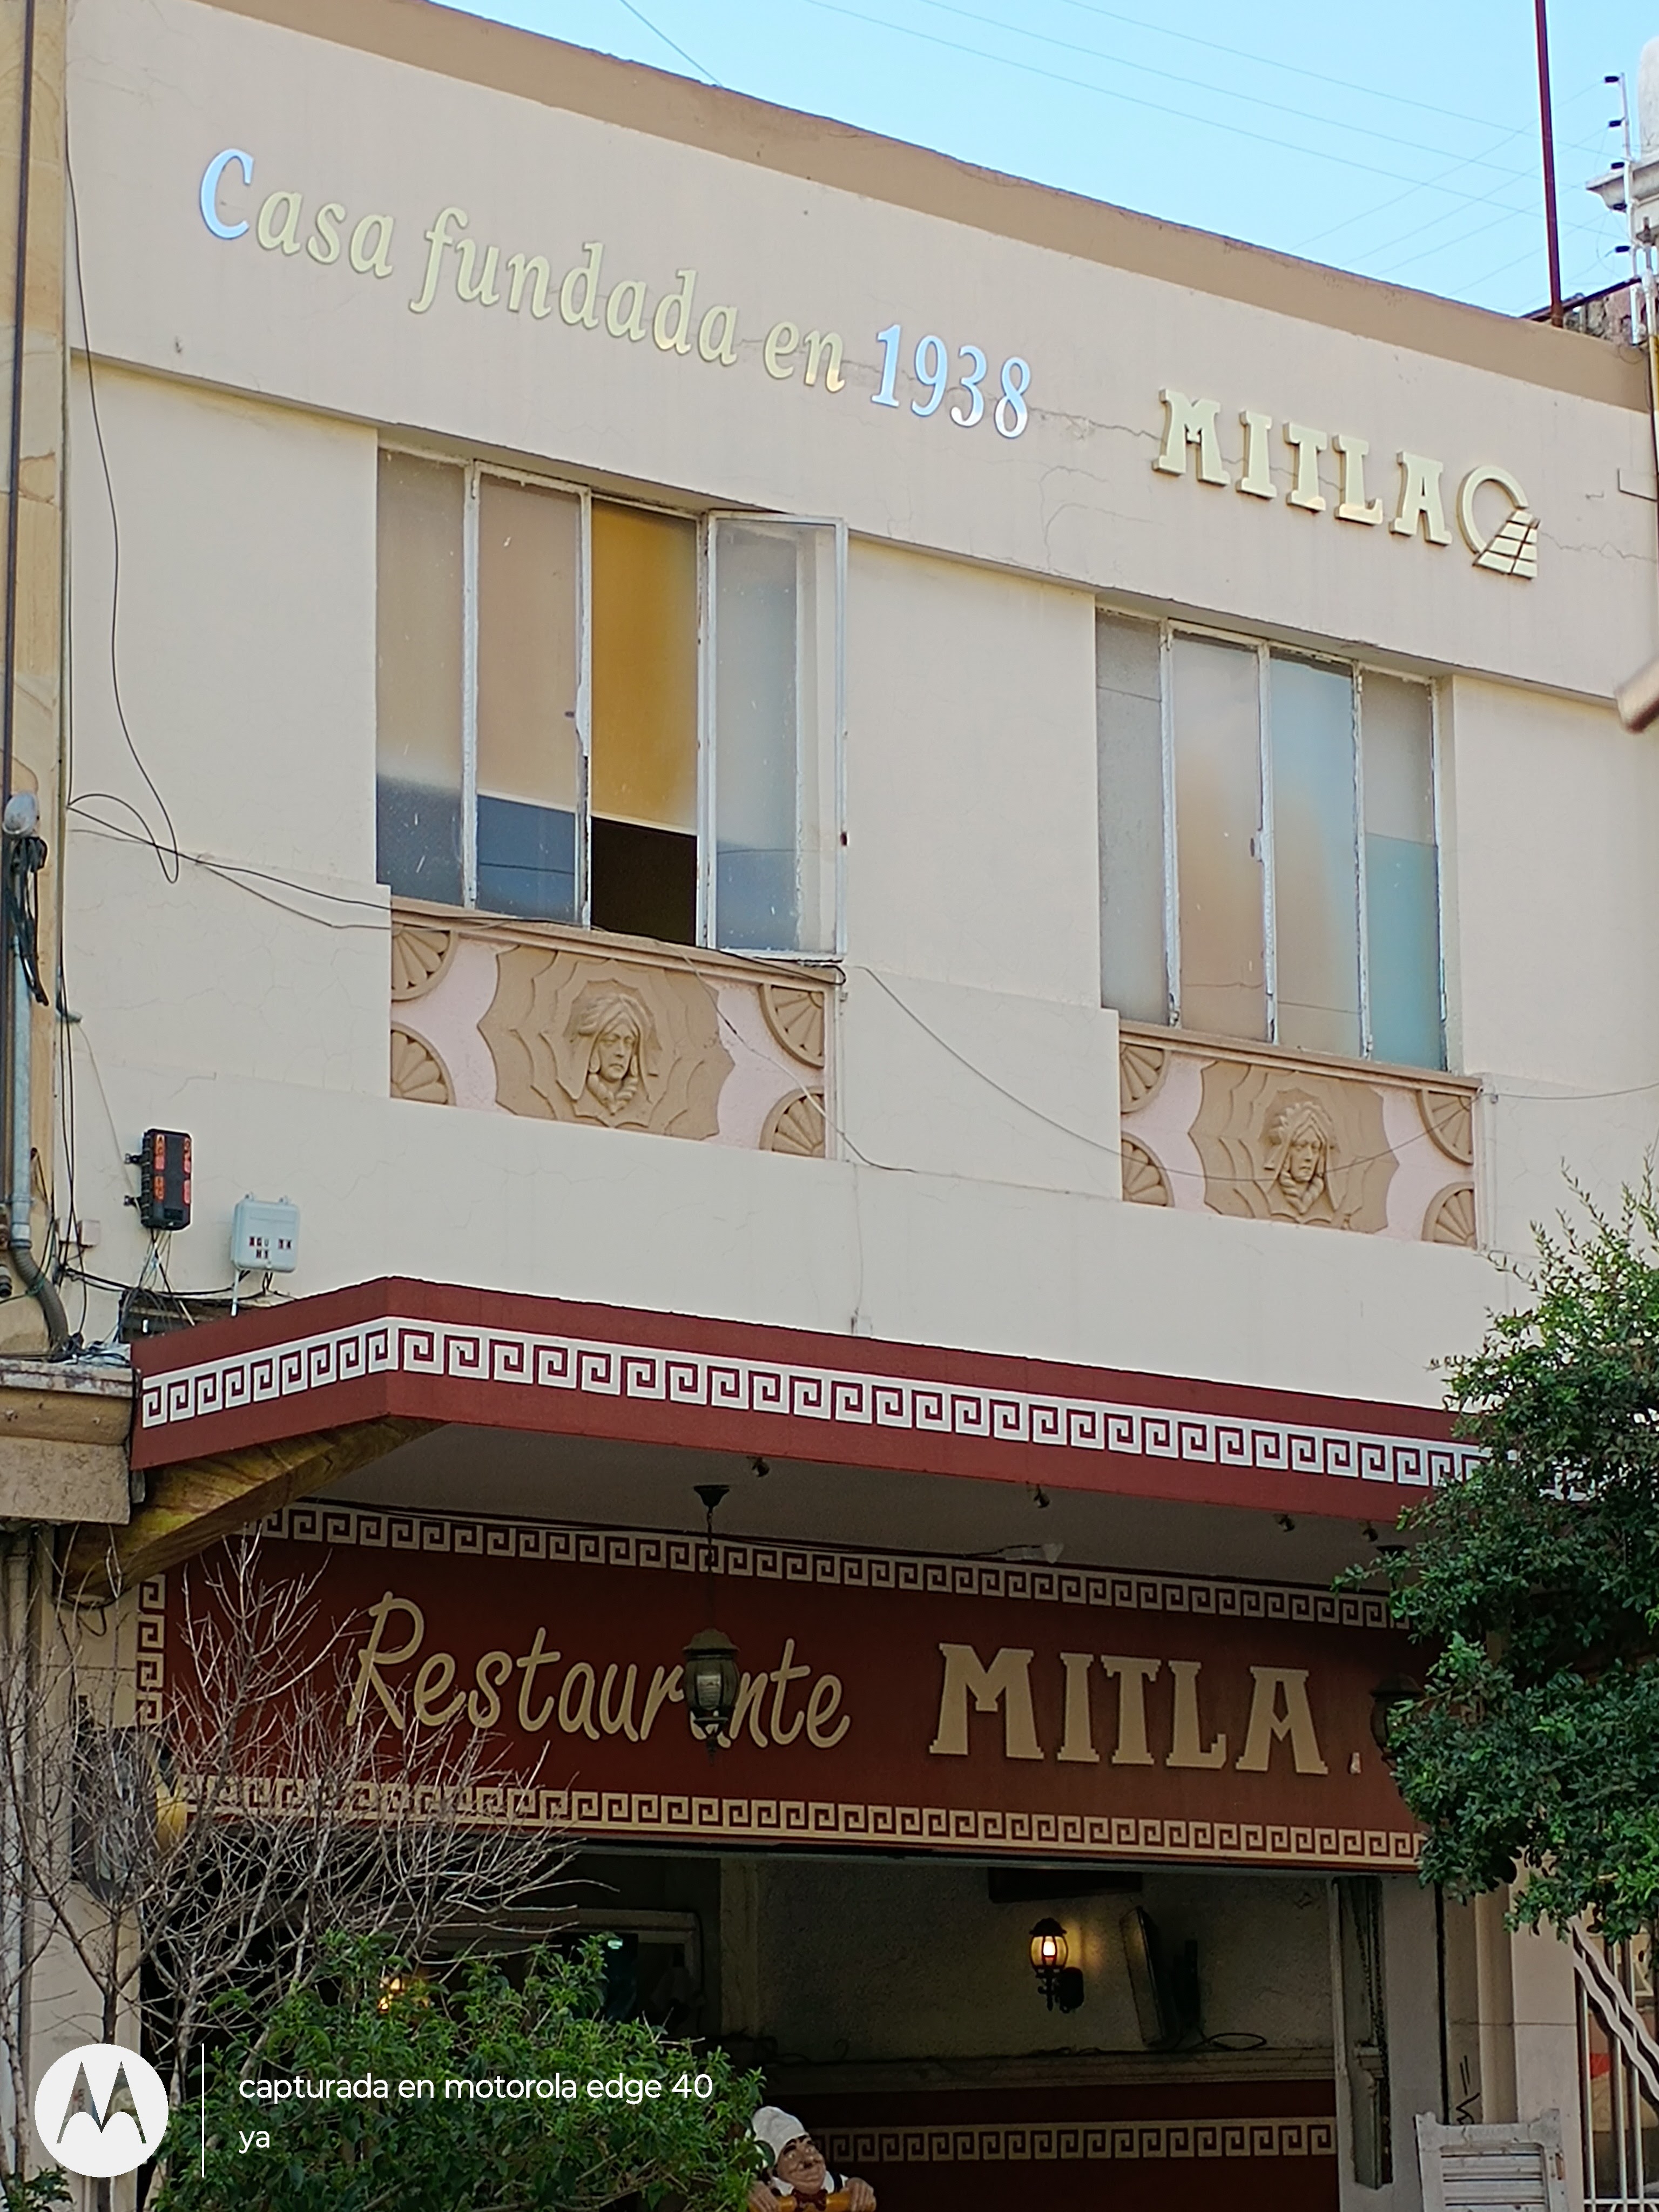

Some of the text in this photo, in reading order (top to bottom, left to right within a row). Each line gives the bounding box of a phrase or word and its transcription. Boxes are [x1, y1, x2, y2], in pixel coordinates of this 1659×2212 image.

[198, 148, 1032, 440] Casa fundada en 1938
[1151, 387, 1454, 546] MITLA
[346, 1590, 1329, 1776] Restaurnte MITLA
